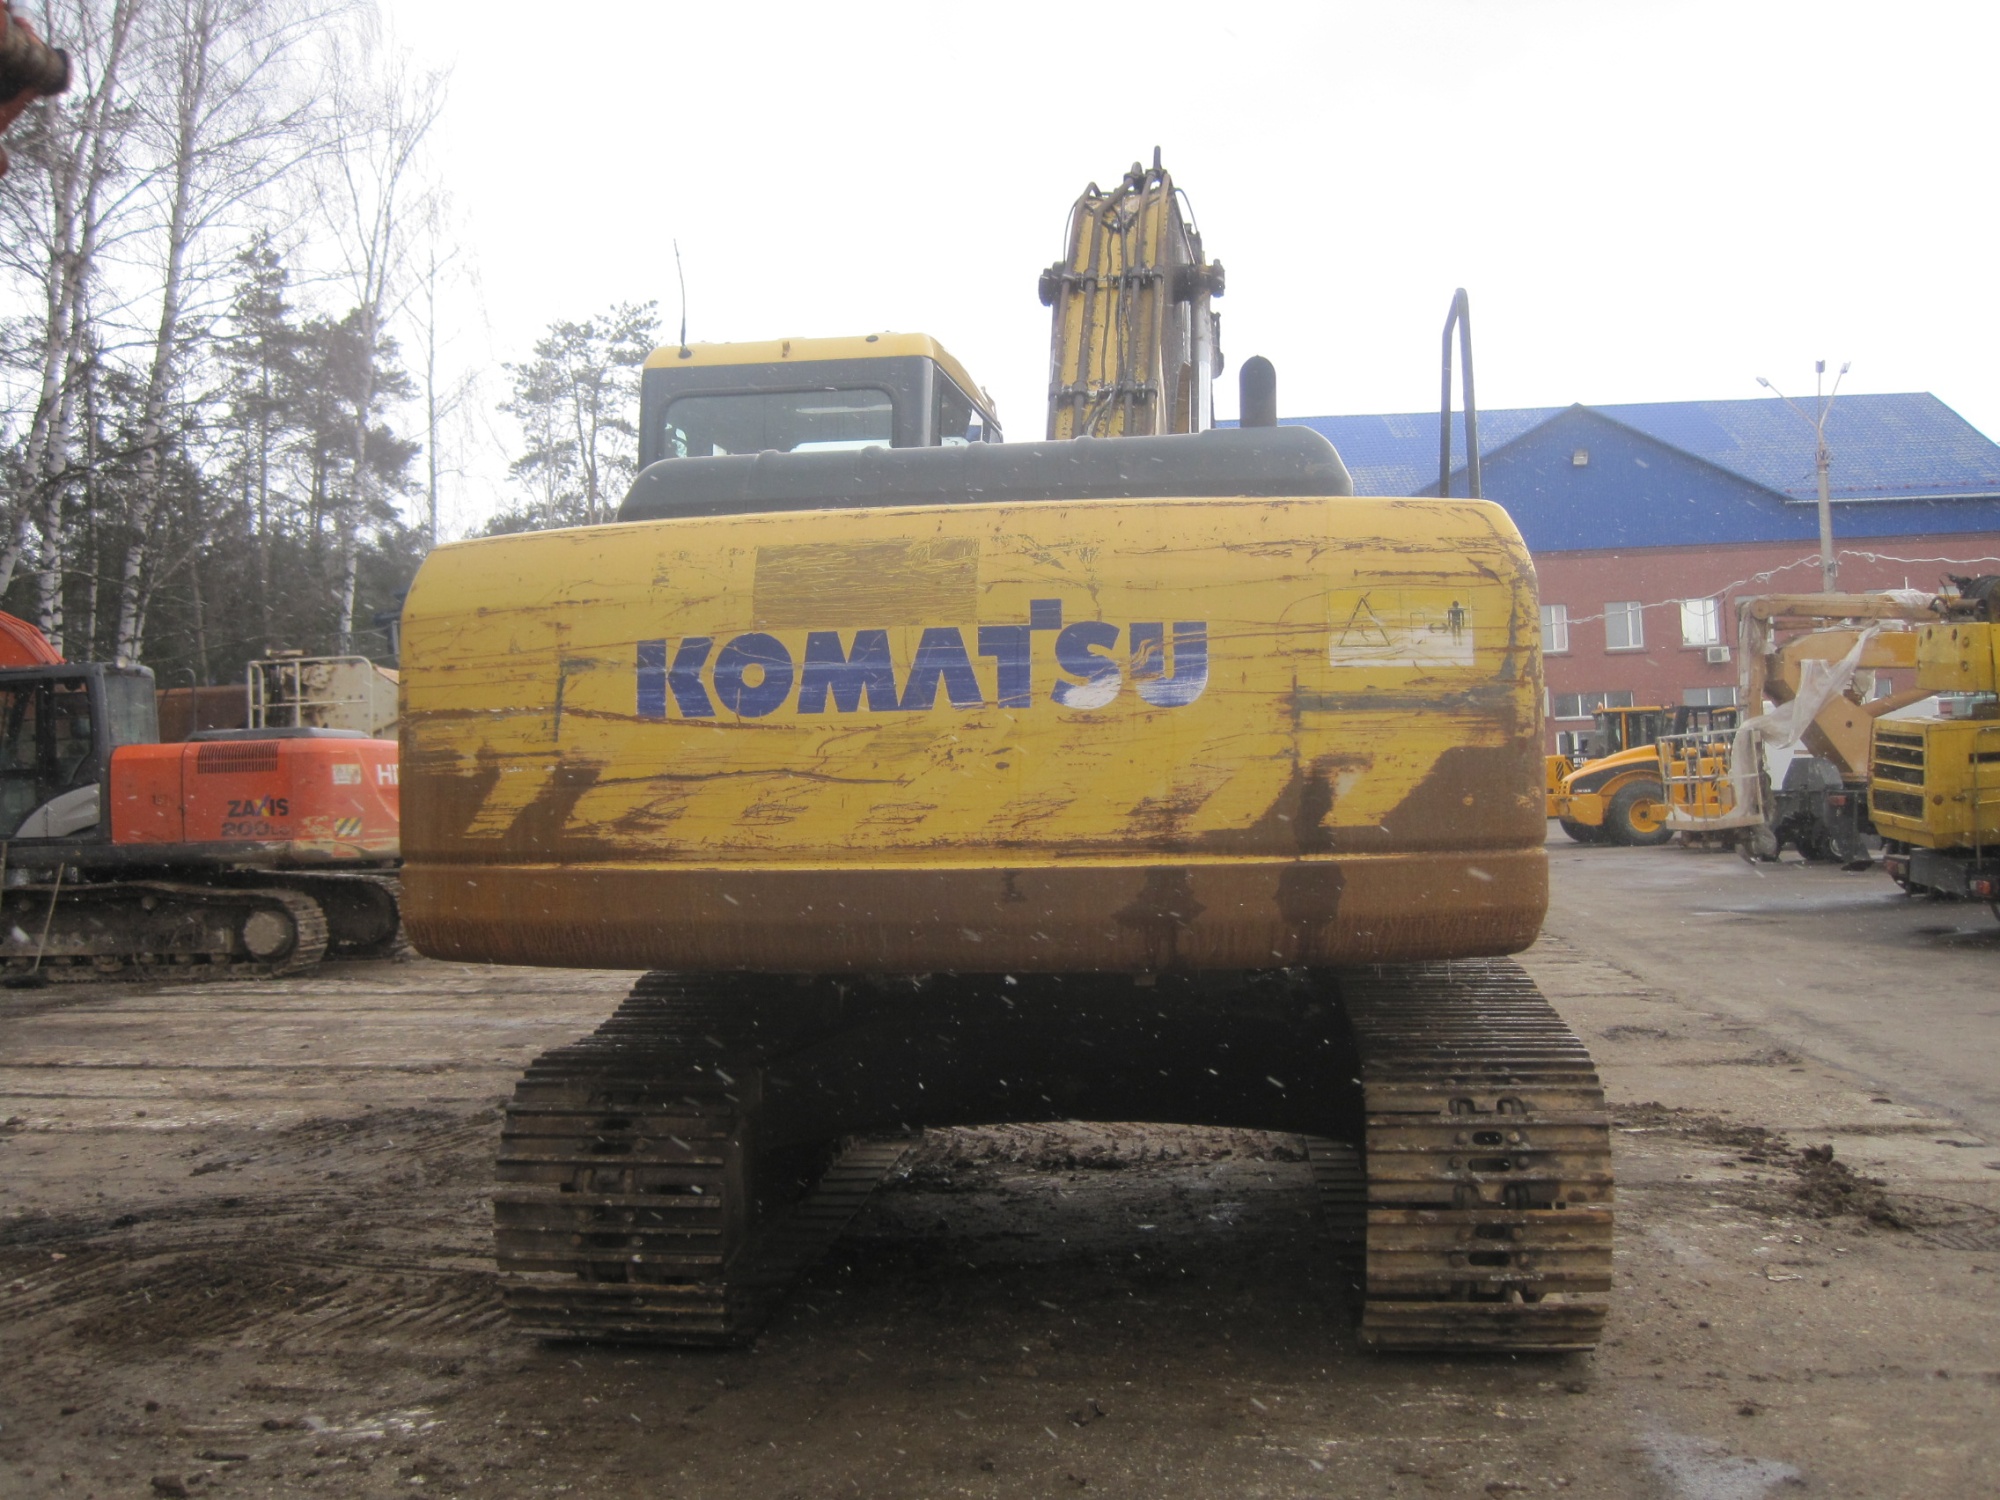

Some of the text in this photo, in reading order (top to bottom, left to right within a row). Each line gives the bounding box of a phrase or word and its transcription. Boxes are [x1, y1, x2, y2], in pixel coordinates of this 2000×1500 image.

[636, 598, 1208, 719] KOMATSU
[376, 763, 399, 786] HI
[227, 793, 289, 818] ZAXIS
